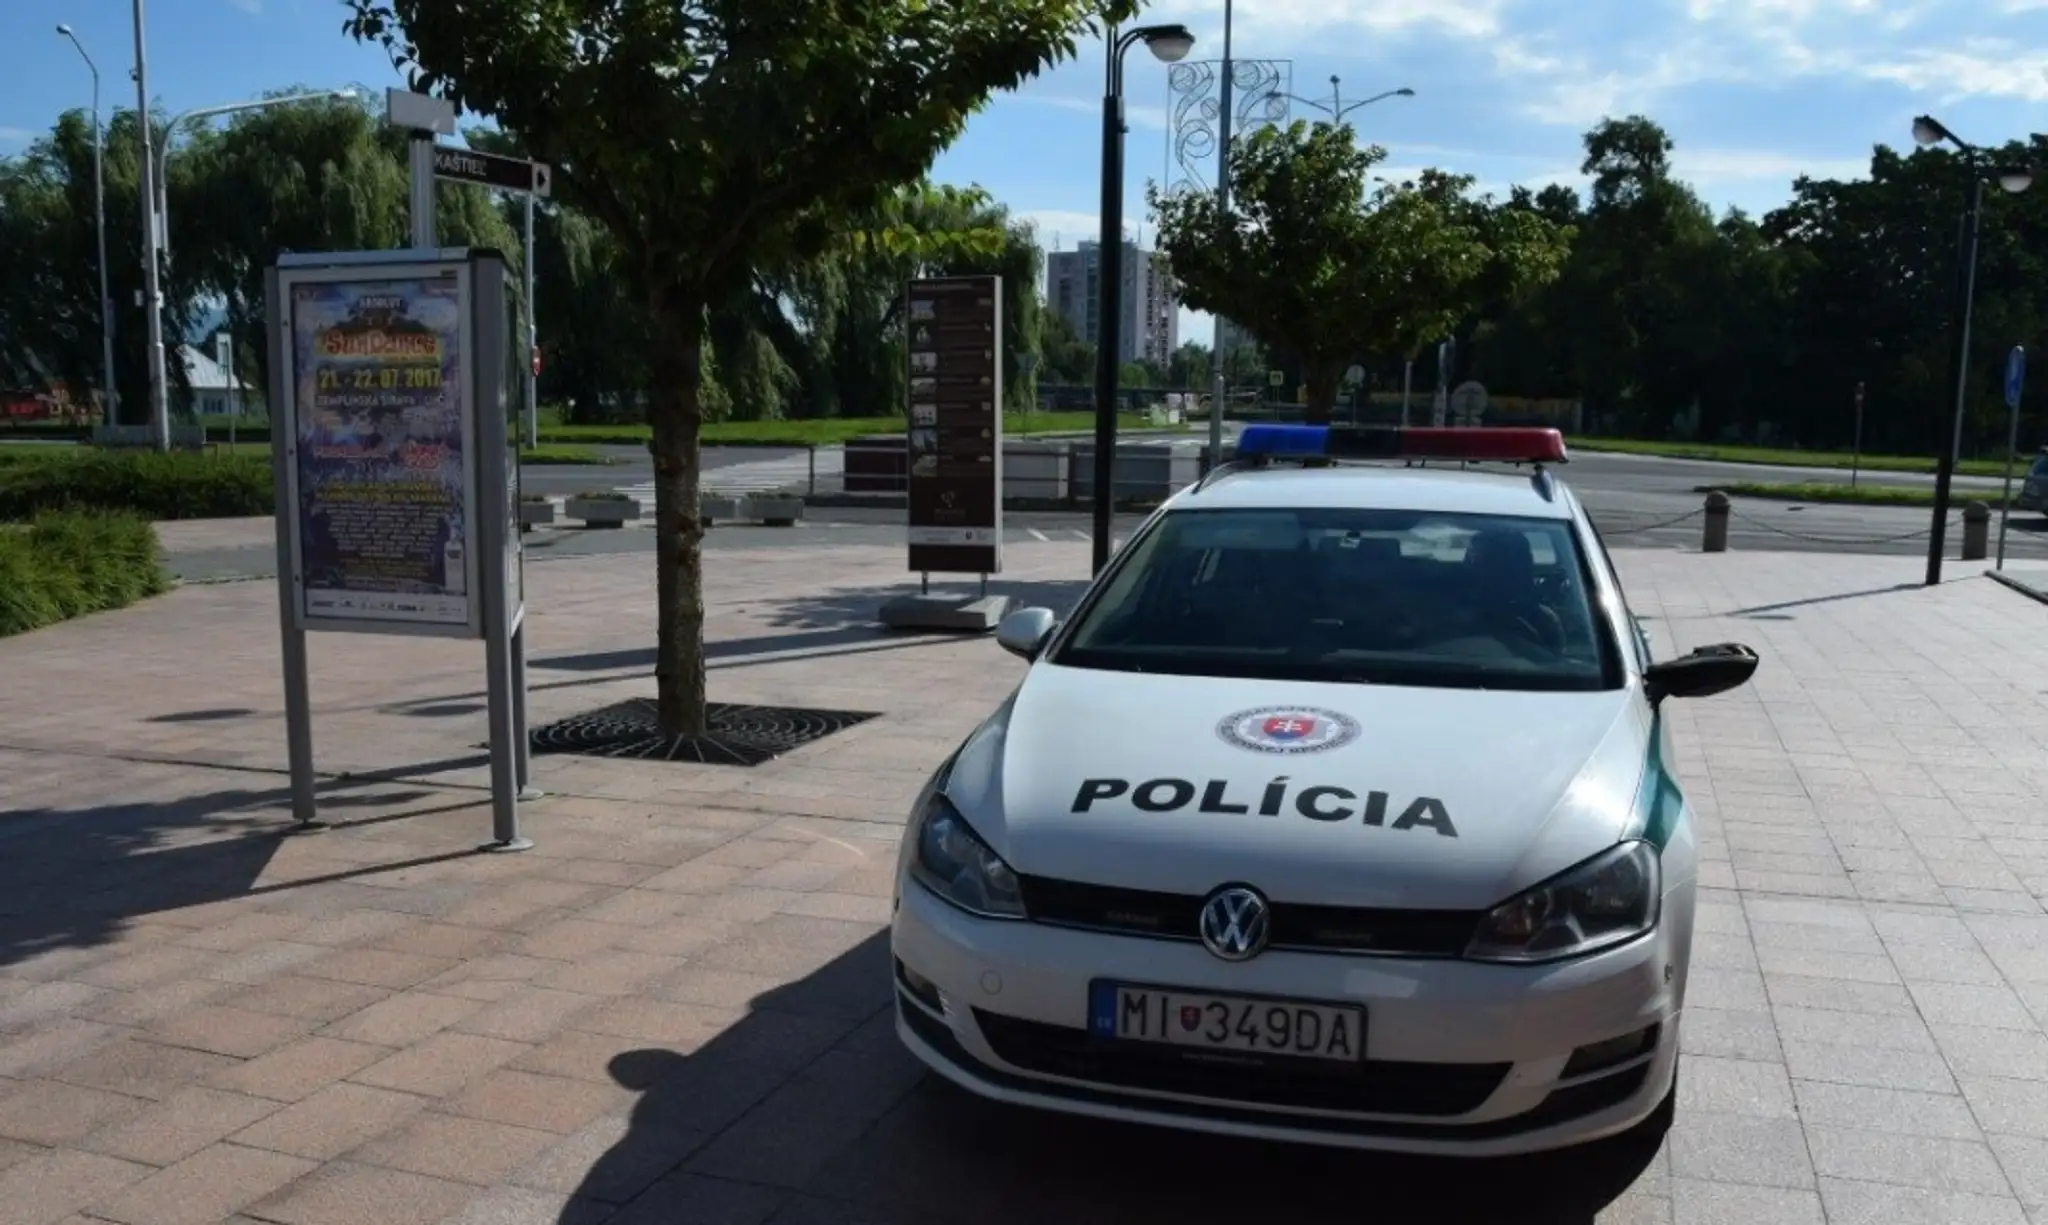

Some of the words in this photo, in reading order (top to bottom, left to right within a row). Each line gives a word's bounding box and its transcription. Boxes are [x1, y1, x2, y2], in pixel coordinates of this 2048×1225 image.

[1070, 775, 1459, 838] POLÍCIA
[1121, 992, 1168, 1037] MI
[1204, 1001, 1352, 1056] 349DA
